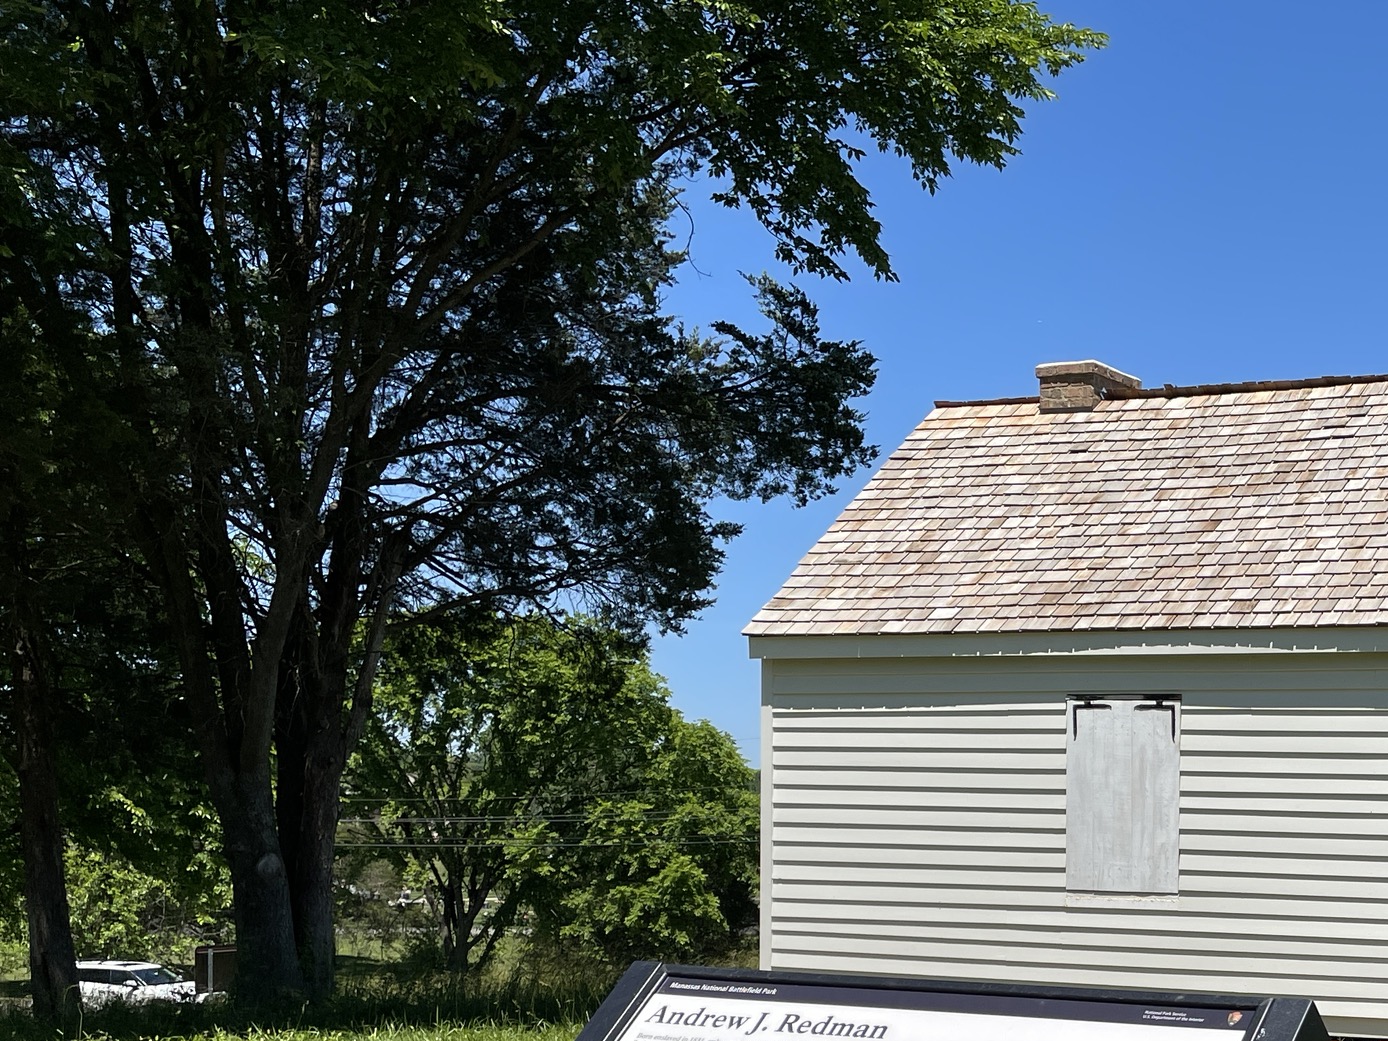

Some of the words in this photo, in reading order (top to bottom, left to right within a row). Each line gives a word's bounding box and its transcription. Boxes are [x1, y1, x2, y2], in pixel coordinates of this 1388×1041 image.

[670, 982, 700, 990] Manassas
[700, 984, 728, 992] National
[728, 986, 762, 994] Battlefield
[645, 1005, 751, 1030] Andrew
[745, 1012, 770, 1036] J.
[775, 1014, 889, 1039] Redman
